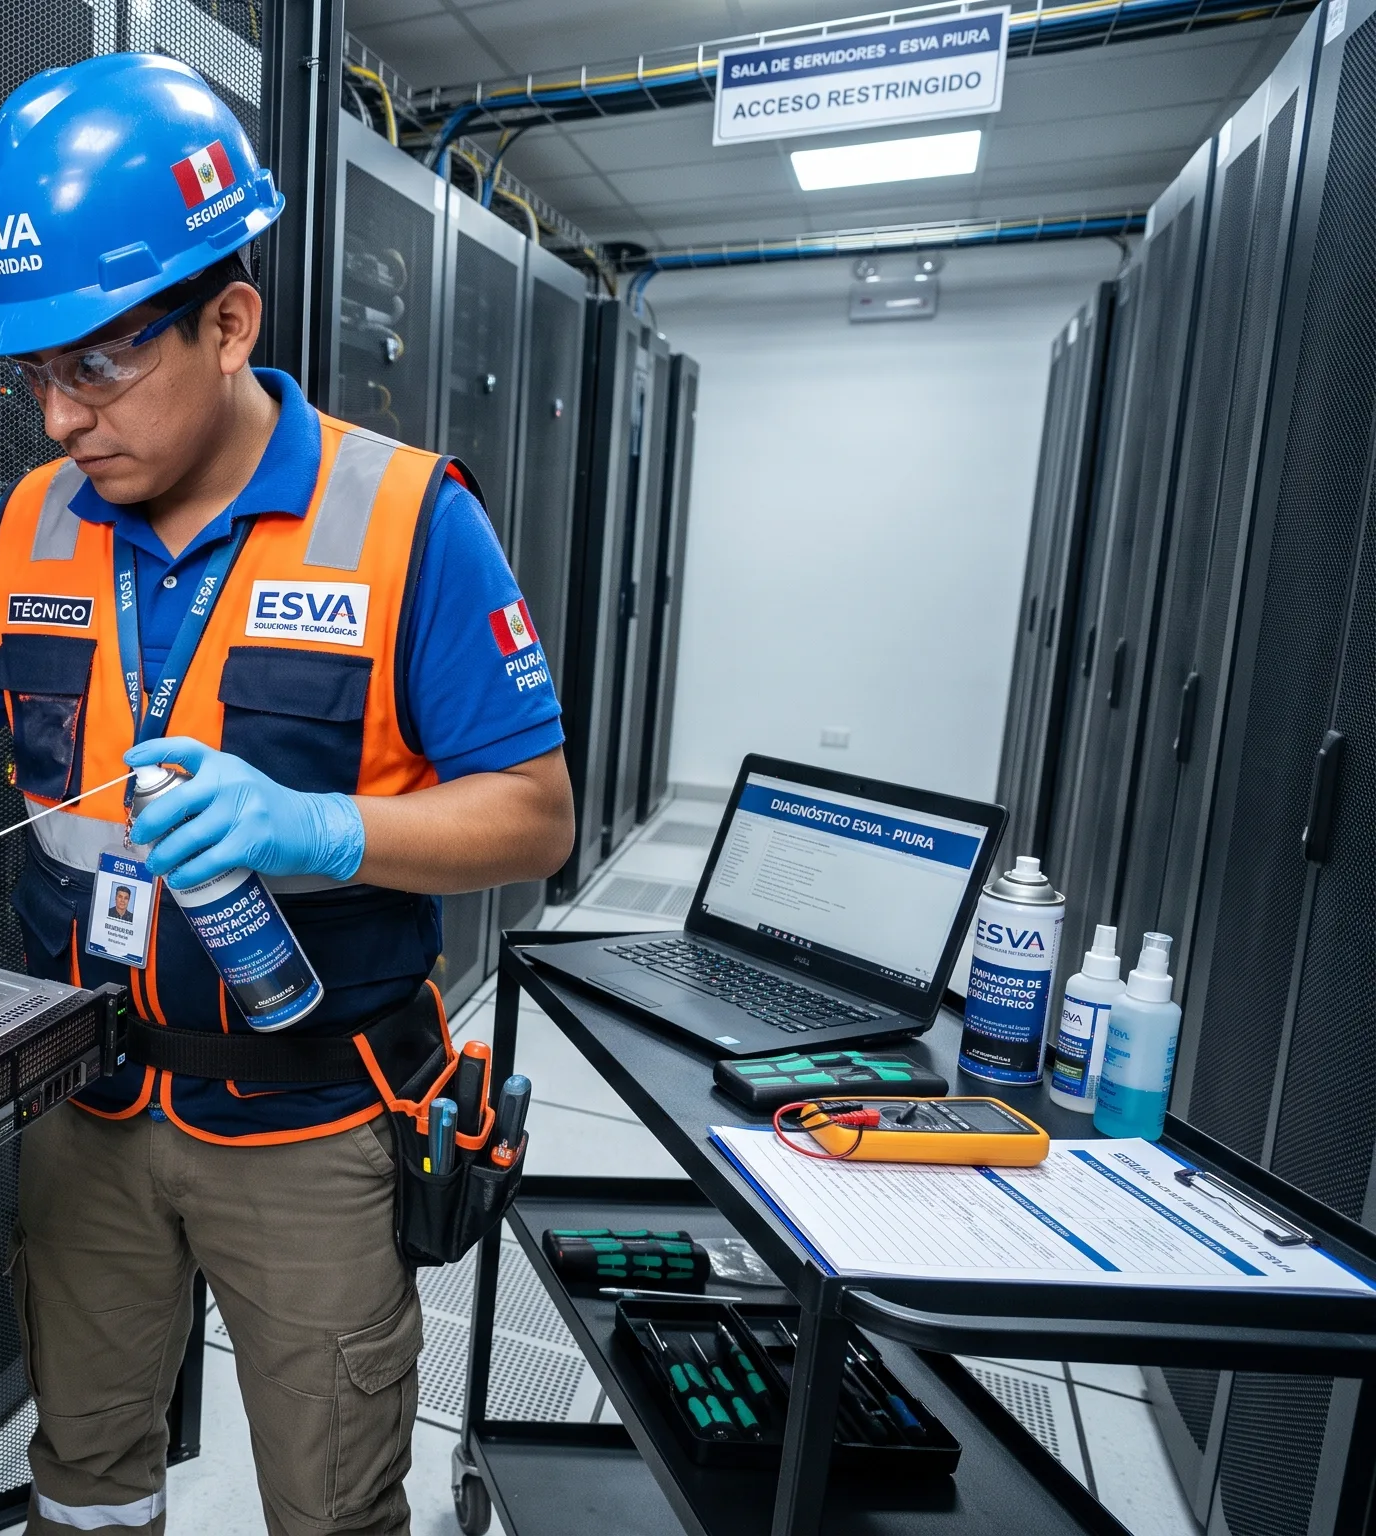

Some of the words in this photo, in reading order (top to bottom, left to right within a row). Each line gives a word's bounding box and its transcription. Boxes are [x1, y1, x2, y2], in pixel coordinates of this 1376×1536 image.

[730, 62, 767, 79] SALA
[771, 58, 790, 73] DE
[793, 43, 886, 71] SERVIDORES
[899, 38, 939, 55] ESVA
[942, 27, 990, 48] PIURA
[733, 93, 821, 120] ACCESO
[827, 71, 982, 108] RESTRINGIDO
[185, 187, 245, 232] SEGURIDAD
[12, 599, 87, 622] TÉCNICO
[256, 591, 358, 625] ESVA
[254, 622, 298, 632] SOLUCIONES
[300, 624, 358, 637] TECNOLÓGICAS
[505, 649, 544, 676] PIURA
[515, 664, 548, 692] PERÚ
[150, 677, 177, 718] ESVA
[770, 798, 850, 829] DIAGNÓSTICO
[851, 818, 883, 837] ESVA
[892, 828, 935, 851] PIURA
[976, 917, 1045, 951] ESVA
[1026, 979, 1043, 990] DE
